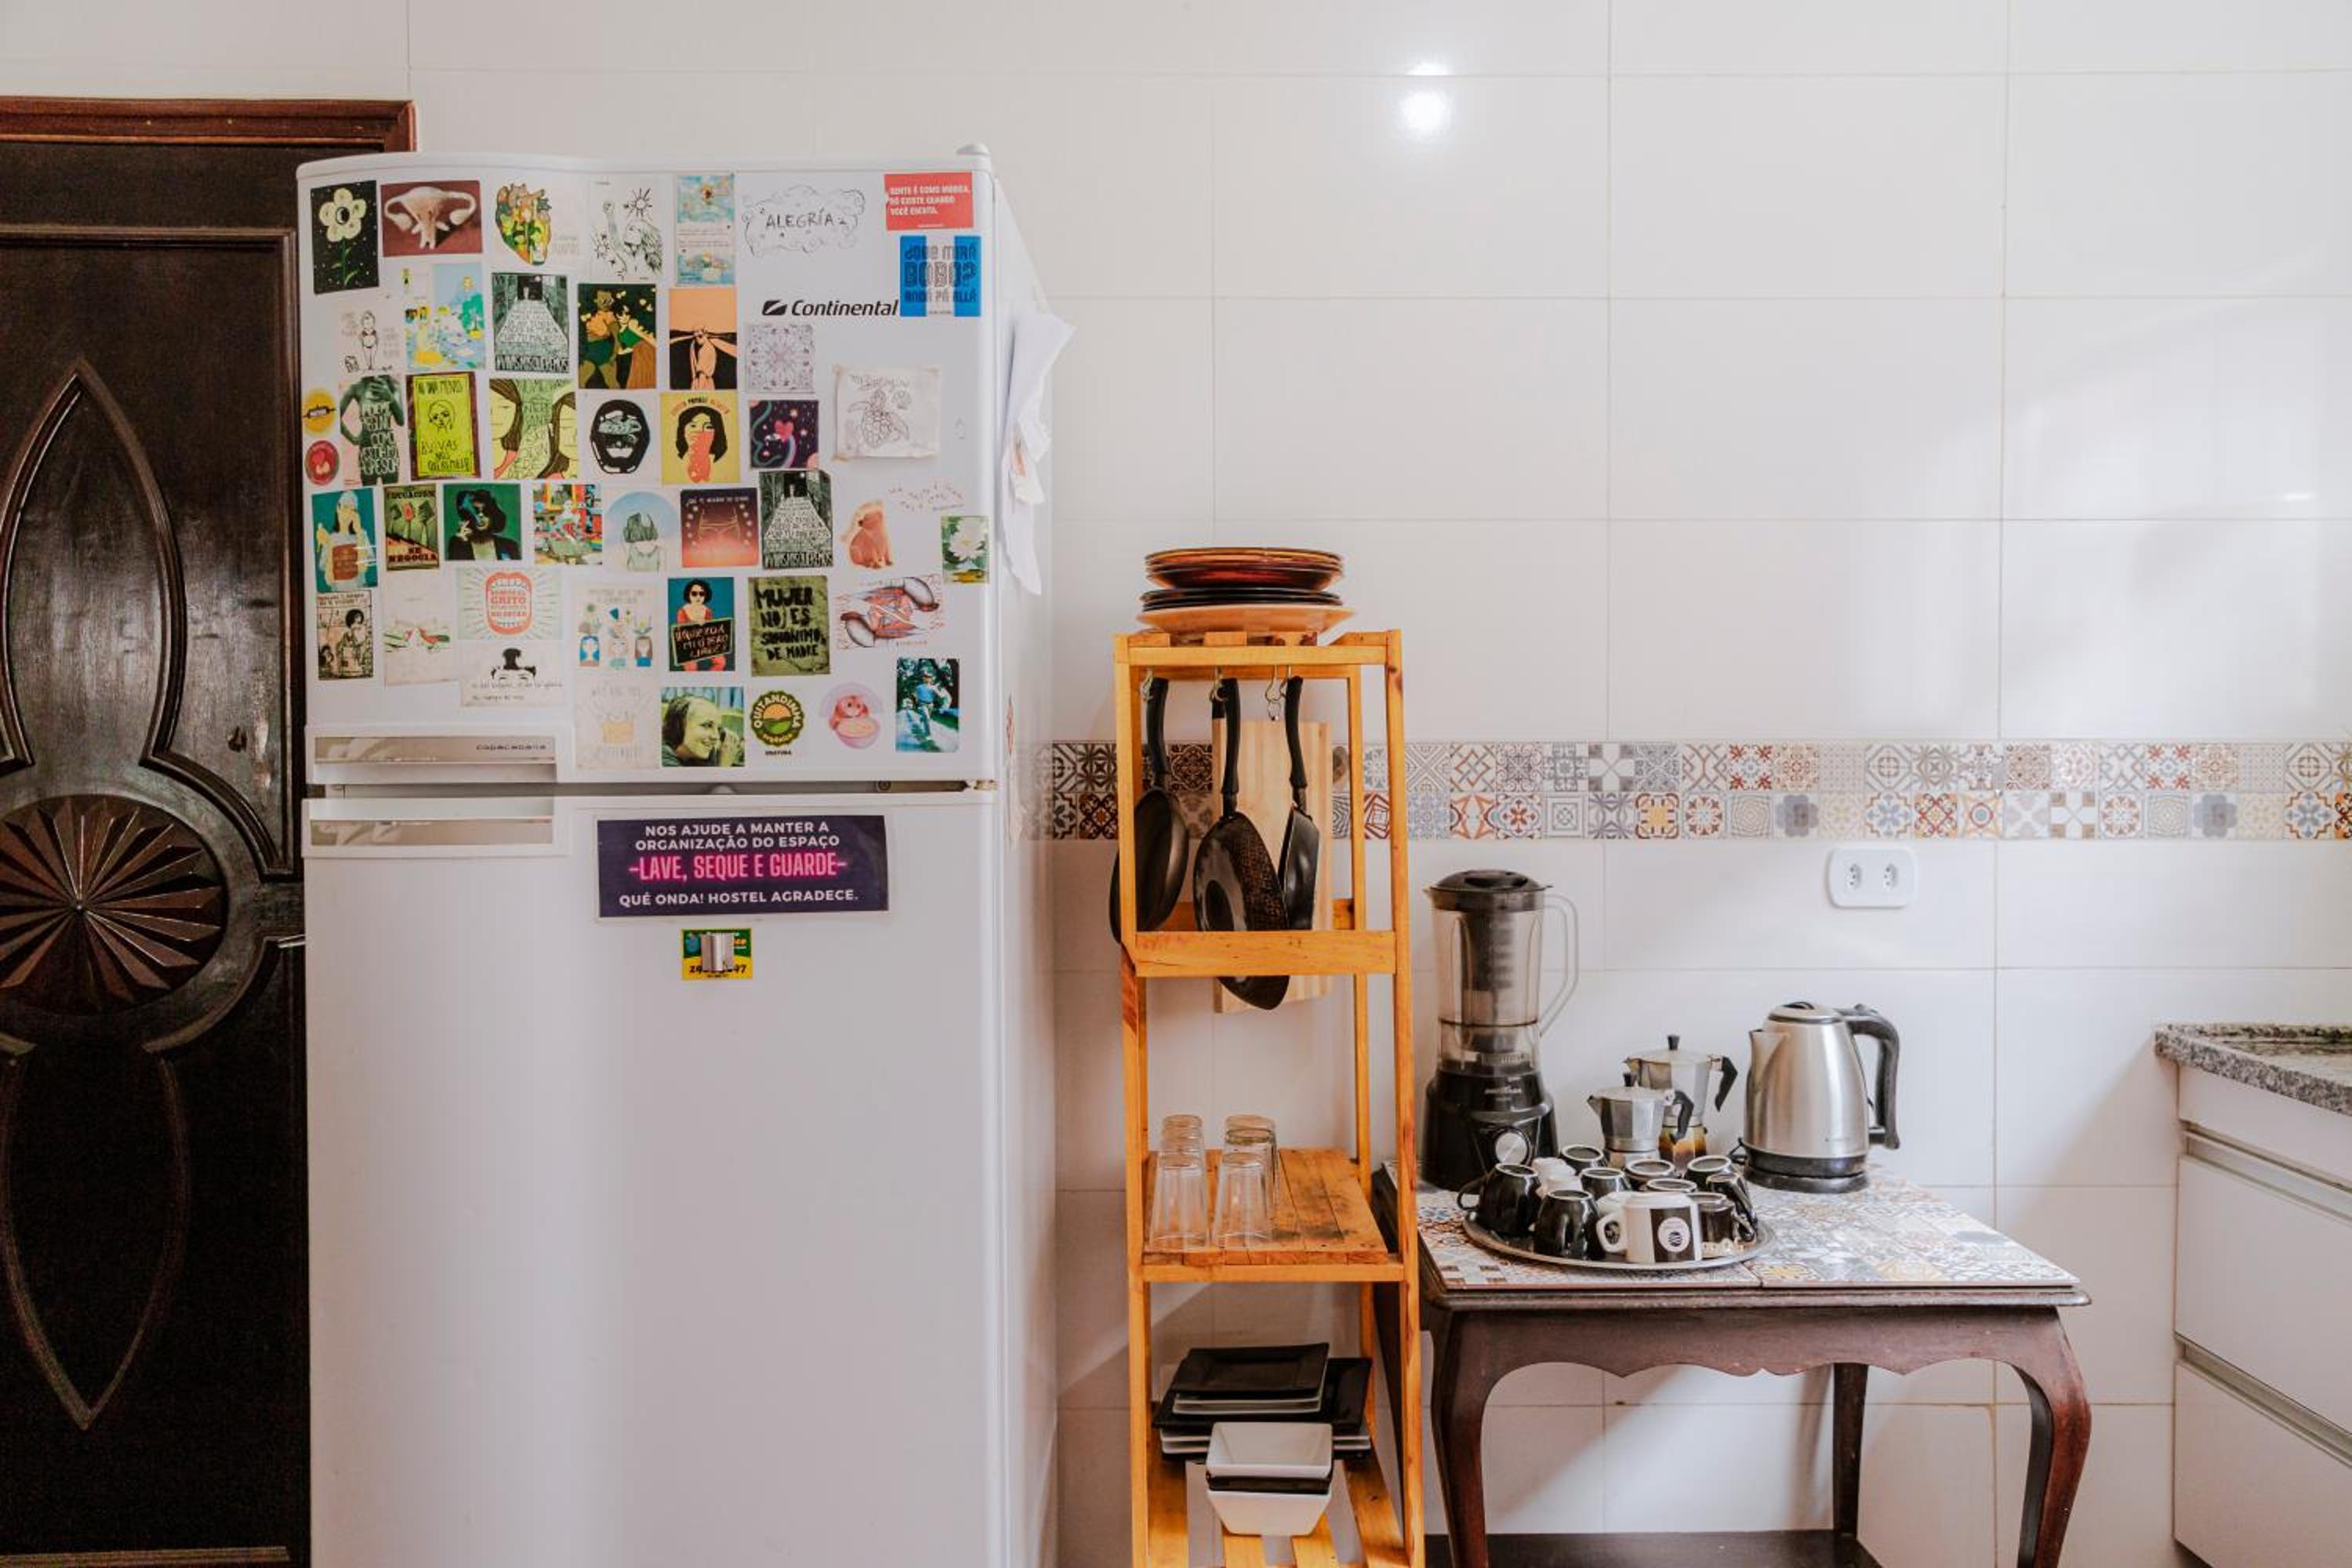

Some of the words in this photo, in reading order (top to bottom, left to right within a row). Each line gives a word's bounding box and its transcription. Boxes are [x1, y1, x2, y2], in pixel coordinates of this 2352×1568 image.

[791, 299, 899, 316] Continental
[753, 585, 814, 609] MUJER
[789, 607, 811, 626] ES
[766, 647, 782, 661] DE
[786, 643, 819, 659] MADRE
[645, 825, 677, 837] NOS
[681, 824, 731, 836] AJUDE
[735, 823, 746, 834] A
[750, 822, 814, 834] MANTER
[819, 821, 829, 833] A
[635, 836, 748, 851] ORGANIZAÇÃO
[753, 837, 774, 848] DO
[779, 835, 840, 849] ESPAÇO
[694, 854, 749, 880] SEQUE
[754, 853, 764, 878] E
[655, 892, 704, 905] ONDA!
[709, 891, 768, 904] HOSTEL
[771, 889, 858, 902] AGRADECE.
